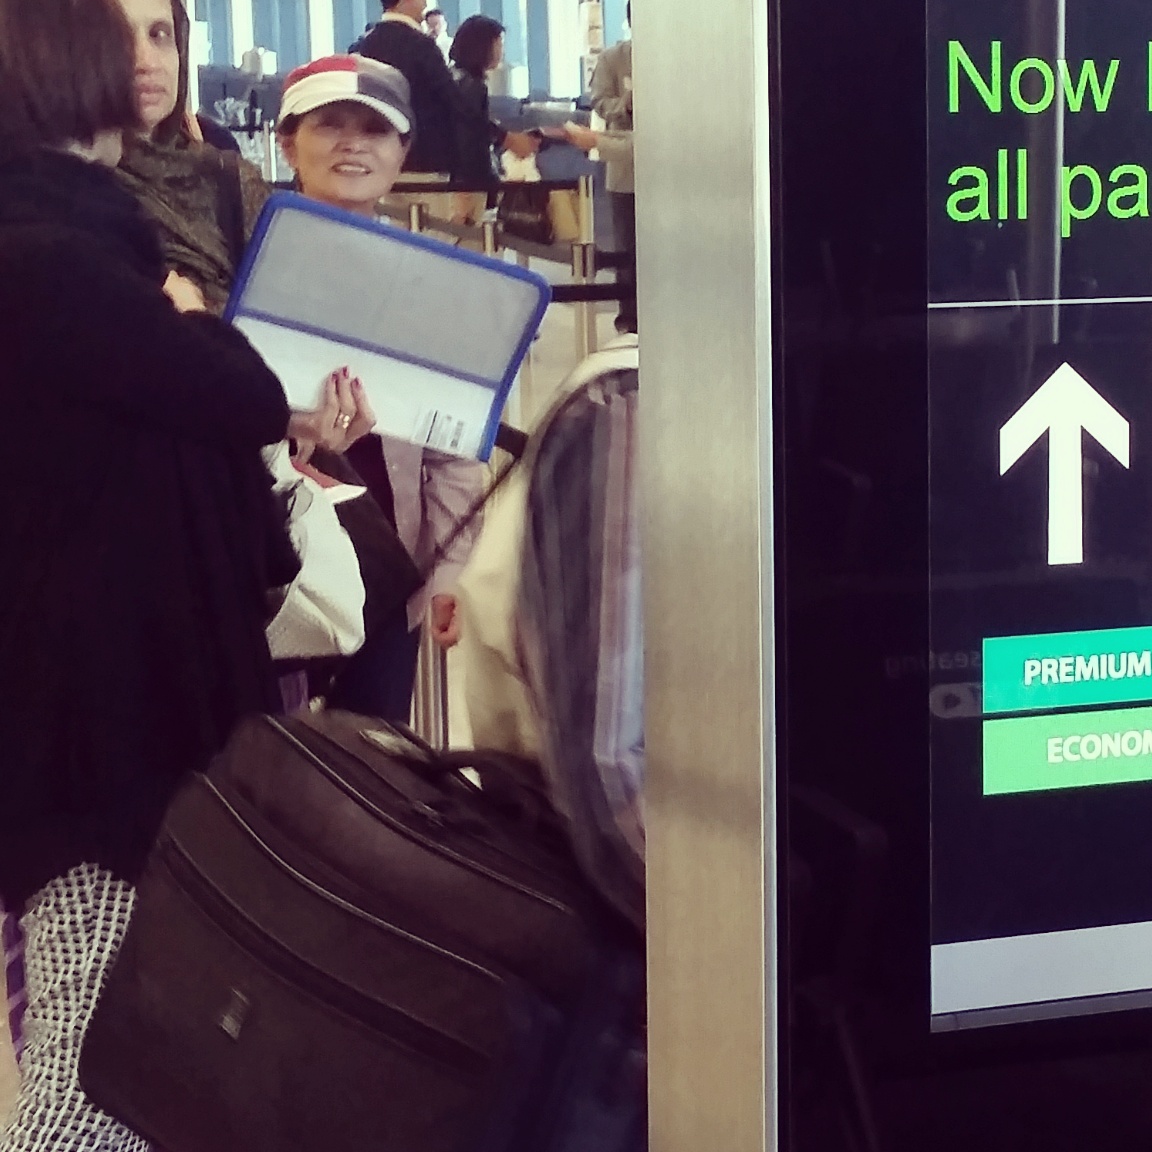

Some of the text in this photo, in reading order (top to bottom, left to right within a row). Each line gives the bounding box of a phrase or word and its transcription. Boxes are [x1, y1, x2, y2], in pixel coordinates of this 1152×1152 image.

[948, 41, 1119, 113] Now
[946, 148, 1028, 222] all
[1024, 650, 1152, 686] PREMIUM
